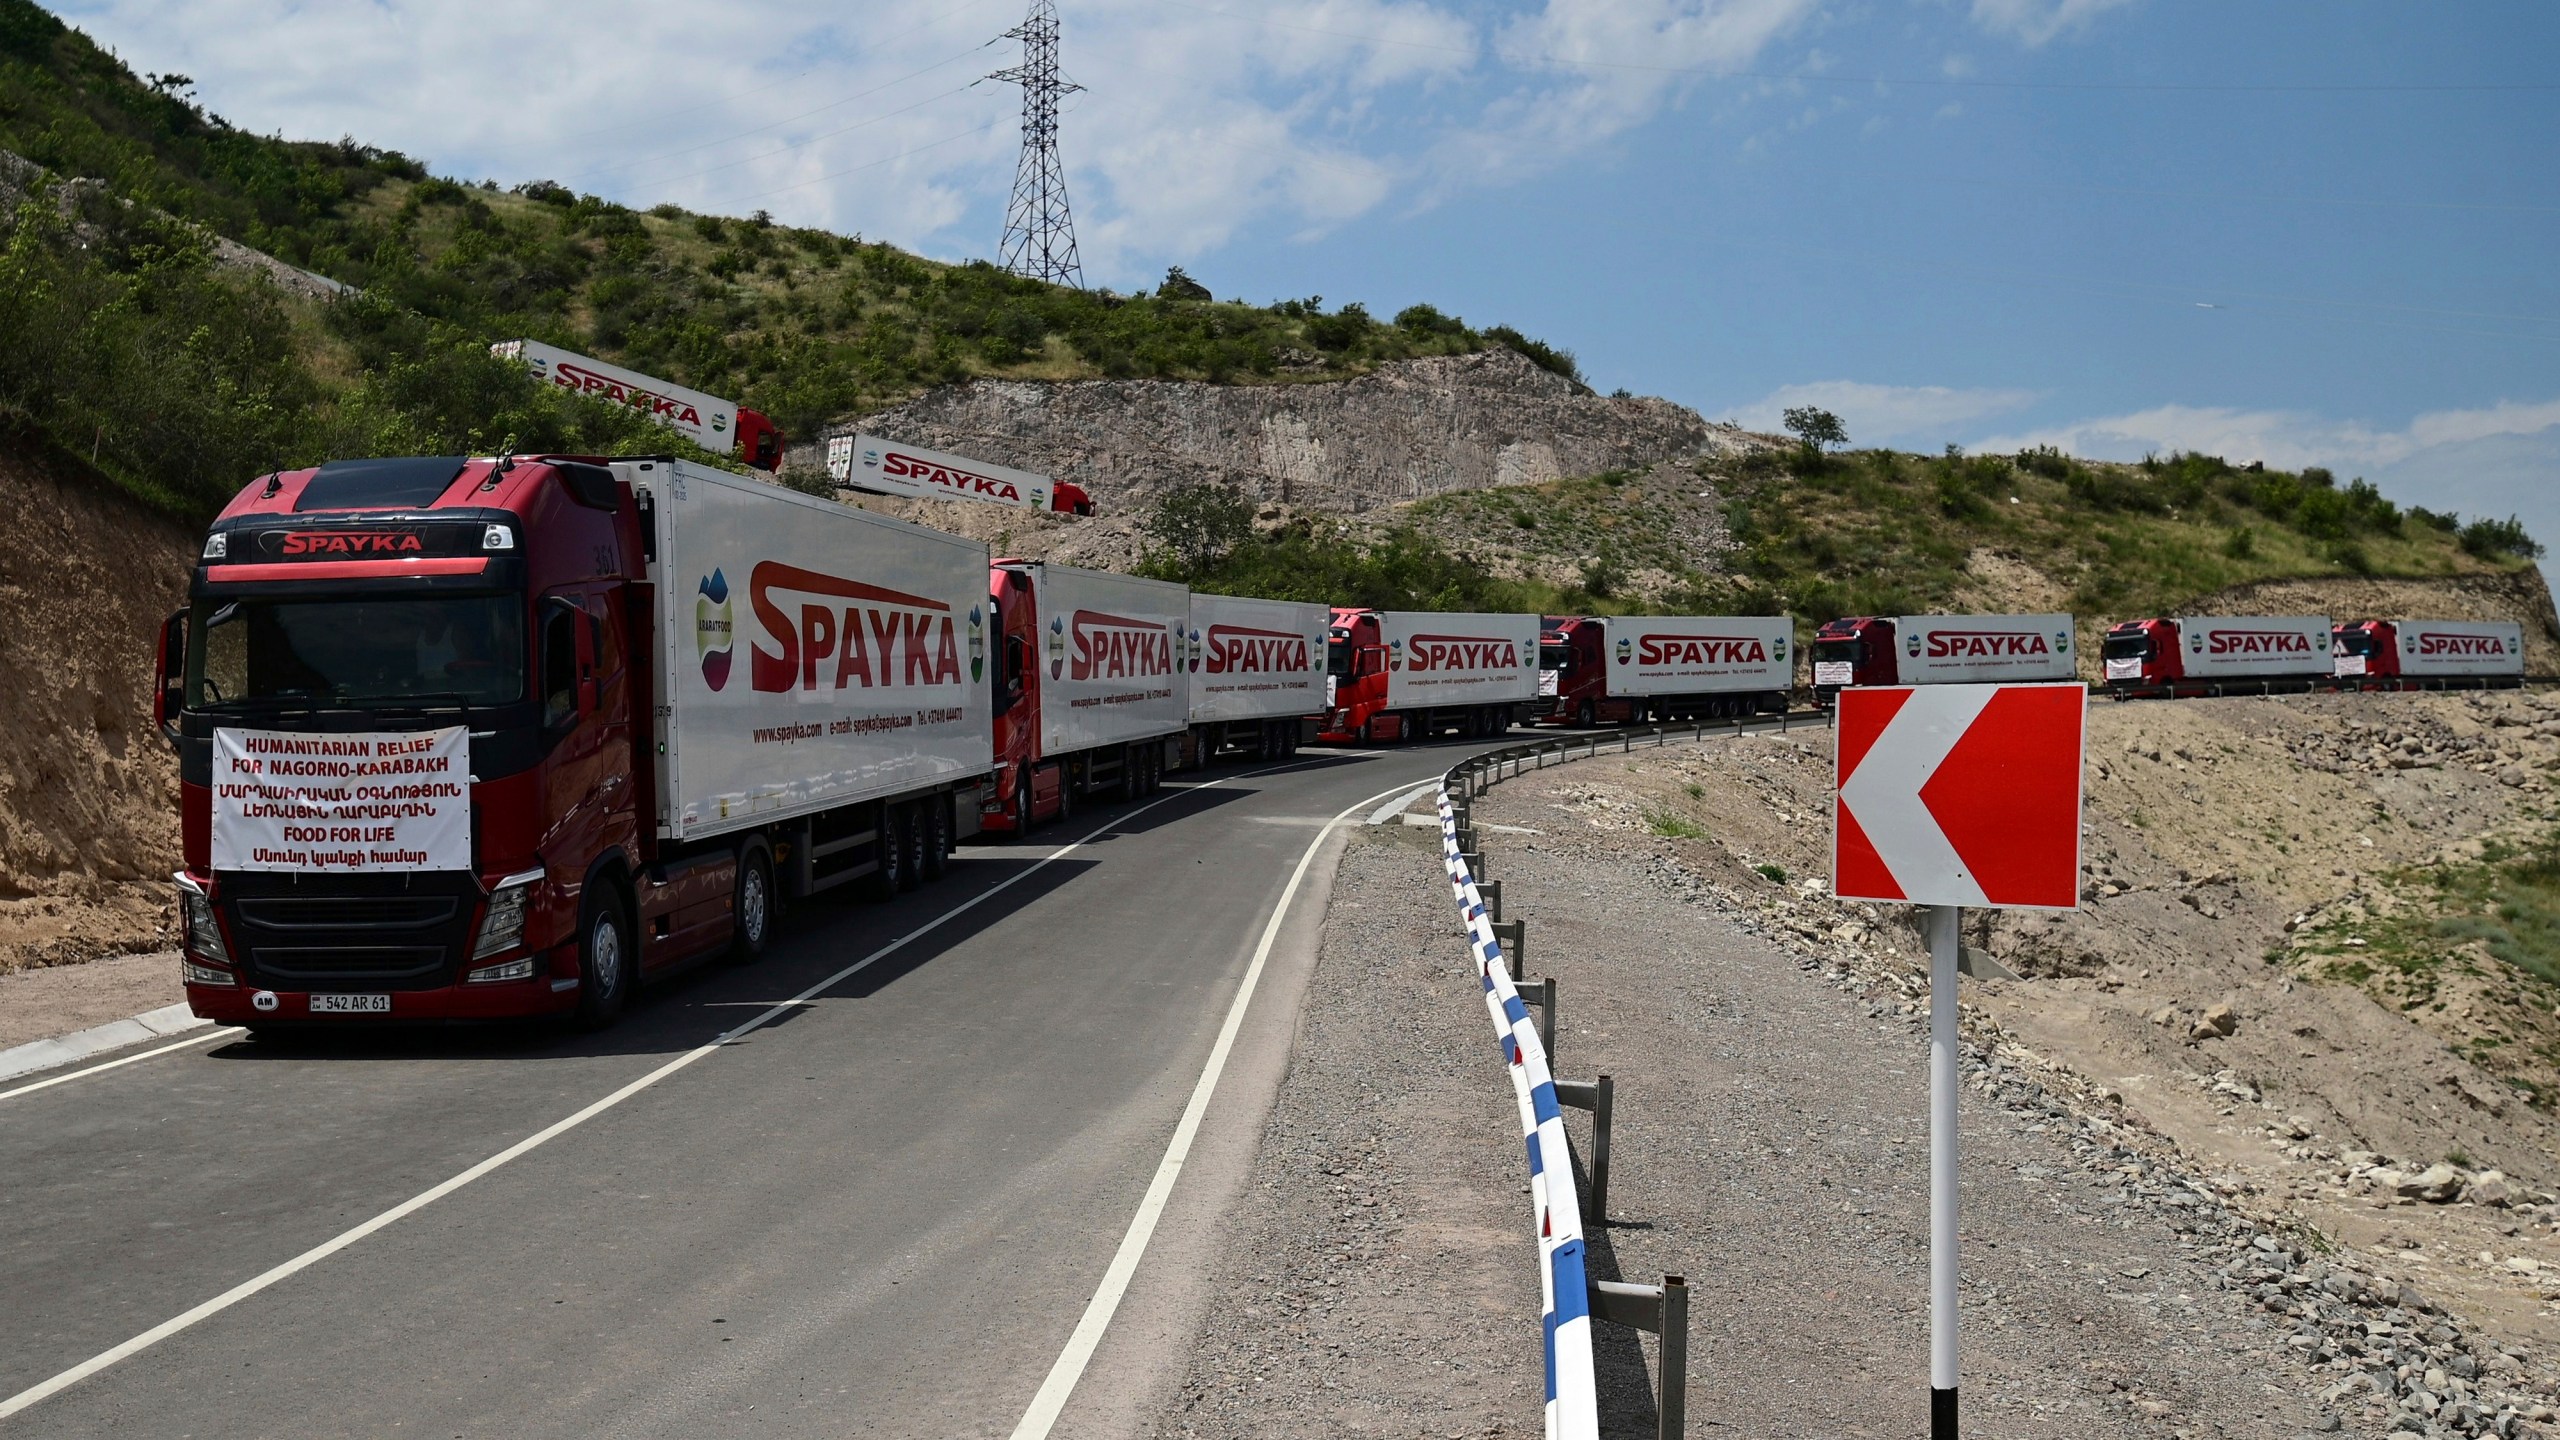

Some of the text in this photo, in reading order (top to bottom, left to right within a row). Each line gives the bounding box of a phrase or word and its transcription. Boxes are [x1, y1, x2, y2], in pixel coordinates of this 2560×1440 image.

[883, 453, 1020, 501] SPAYKA
[283, 531, 422, 554] SPAYKA
[699, 619, 731, 632] ARARATFOOD
[750, 560, 961, 693] SPAYKA
[1071, 609, 1171, 681] SPAYKA
[1206, 624, 1308, 673] SPAYKA
[1408, 634, 1517, 671] SPAYKA
[1639, 634, 1766, 665] SPAYKA
[1927, 630, 2048, 657] SPAYKA
[2209, 630, 2311, 654] SPAYKA
[2420, 633, 2504, 655] SPAYKA
[753, 721, 822, 745] www.spayka.com
[829, 715, 852, 736] e-mail:
[853, 713, 913, 736] spayka@spayka.com
[917, 710, 927, 726] Tel.
[246, 738, 434, 756] HUMANITARIAN RELIEF
[232, 757, 448, 777] FOR NAGORNO-KARABAKH
[219, 782, 462, 801] ՄԱՐԴԱՍԻՐԱԿԱՆ ՕԳՆՈՒԹՅՈՒՆ
[243, 803, 436, 819] ԼԵՌՆԱՅԻՆ ՂԱՐԱԲԱՂԻՆ
[284, 826, 395, 842] FOOD FOR LIFE
[253, 848, 427, 867] Սնունդ կյանքի համար
[257, 997, 273, 1006] AM
[326, 996, 387, 1010] 542 AR 61
